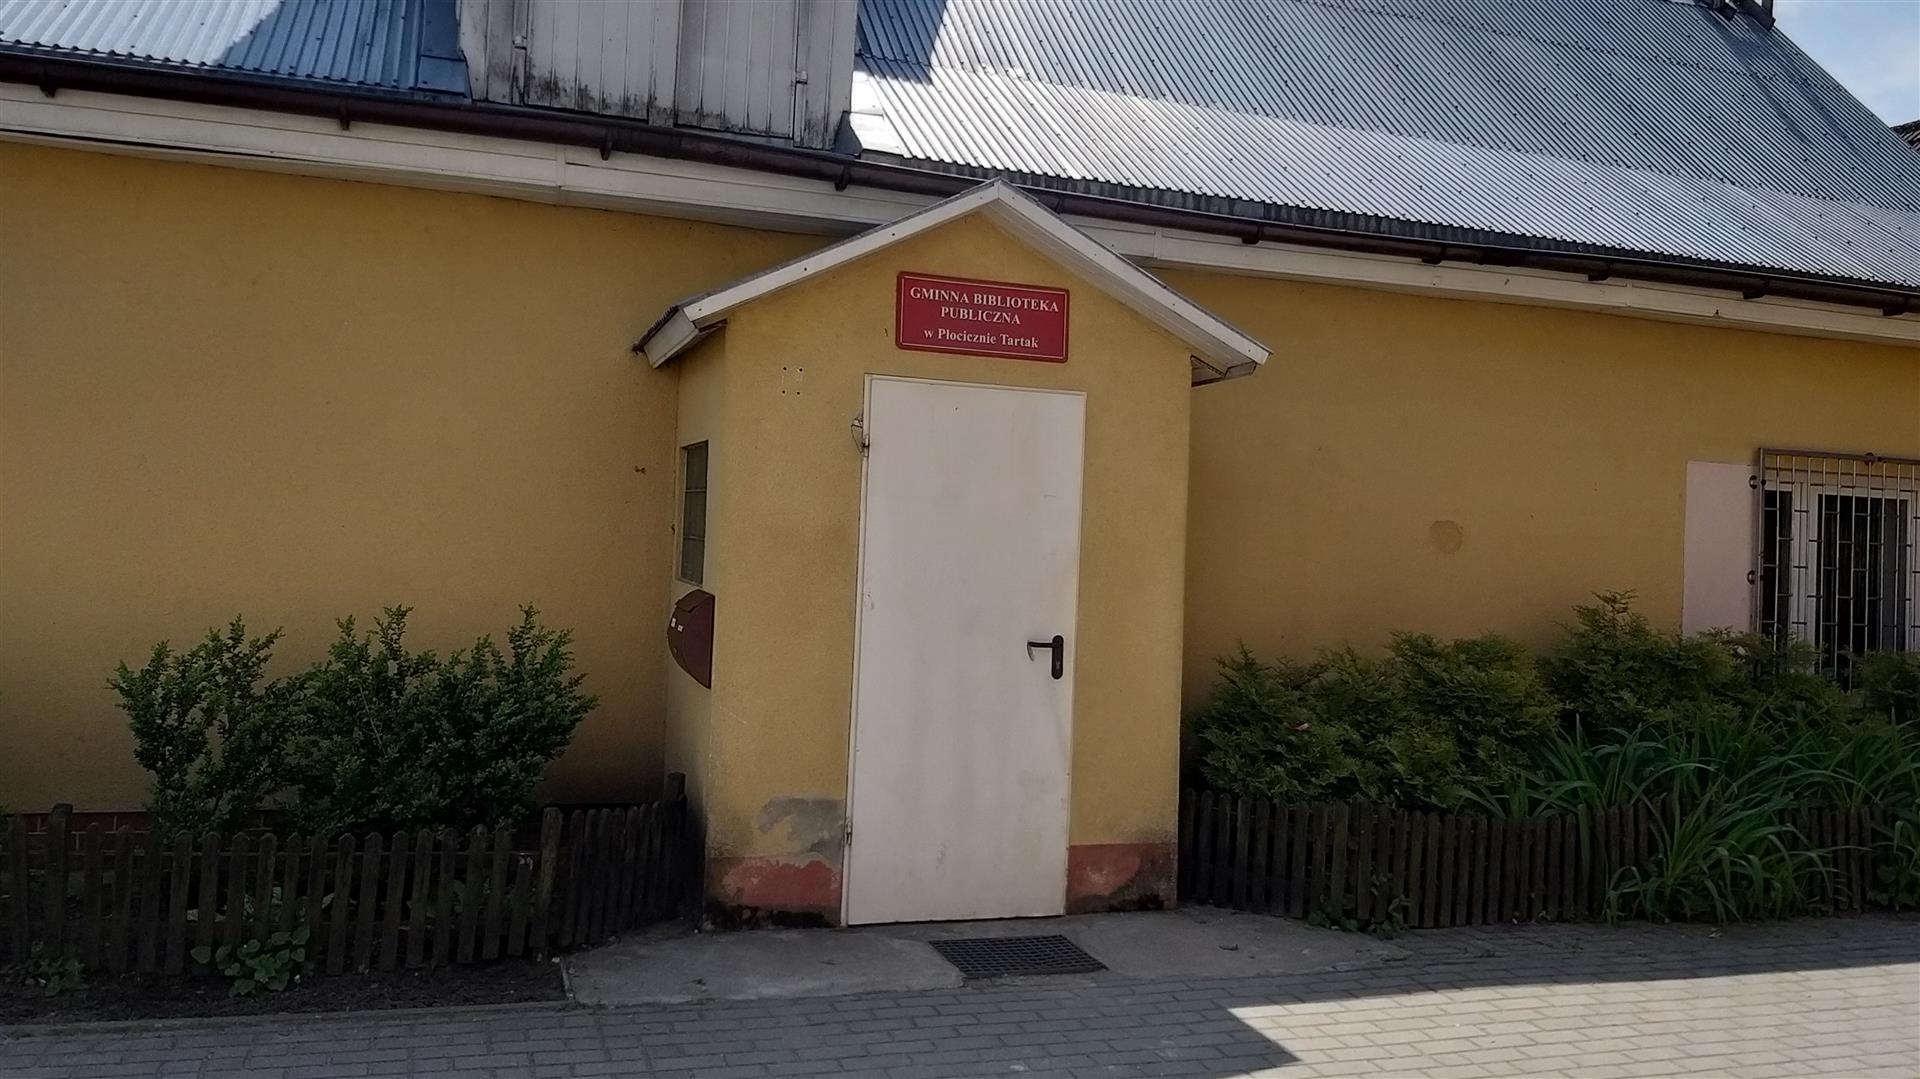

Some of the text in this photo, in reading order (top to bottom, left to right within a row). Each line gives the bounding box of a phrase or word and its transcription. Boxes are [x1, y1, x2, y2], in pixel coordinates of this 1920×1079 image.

[910, 286, 1059, 312] GMINNA BIBLIOTEKA
[941, 306, 1021, 325] PUBLICZNA
[924, 330, 934, 339] w
[1000, 334, 1039, 348] Tartak
